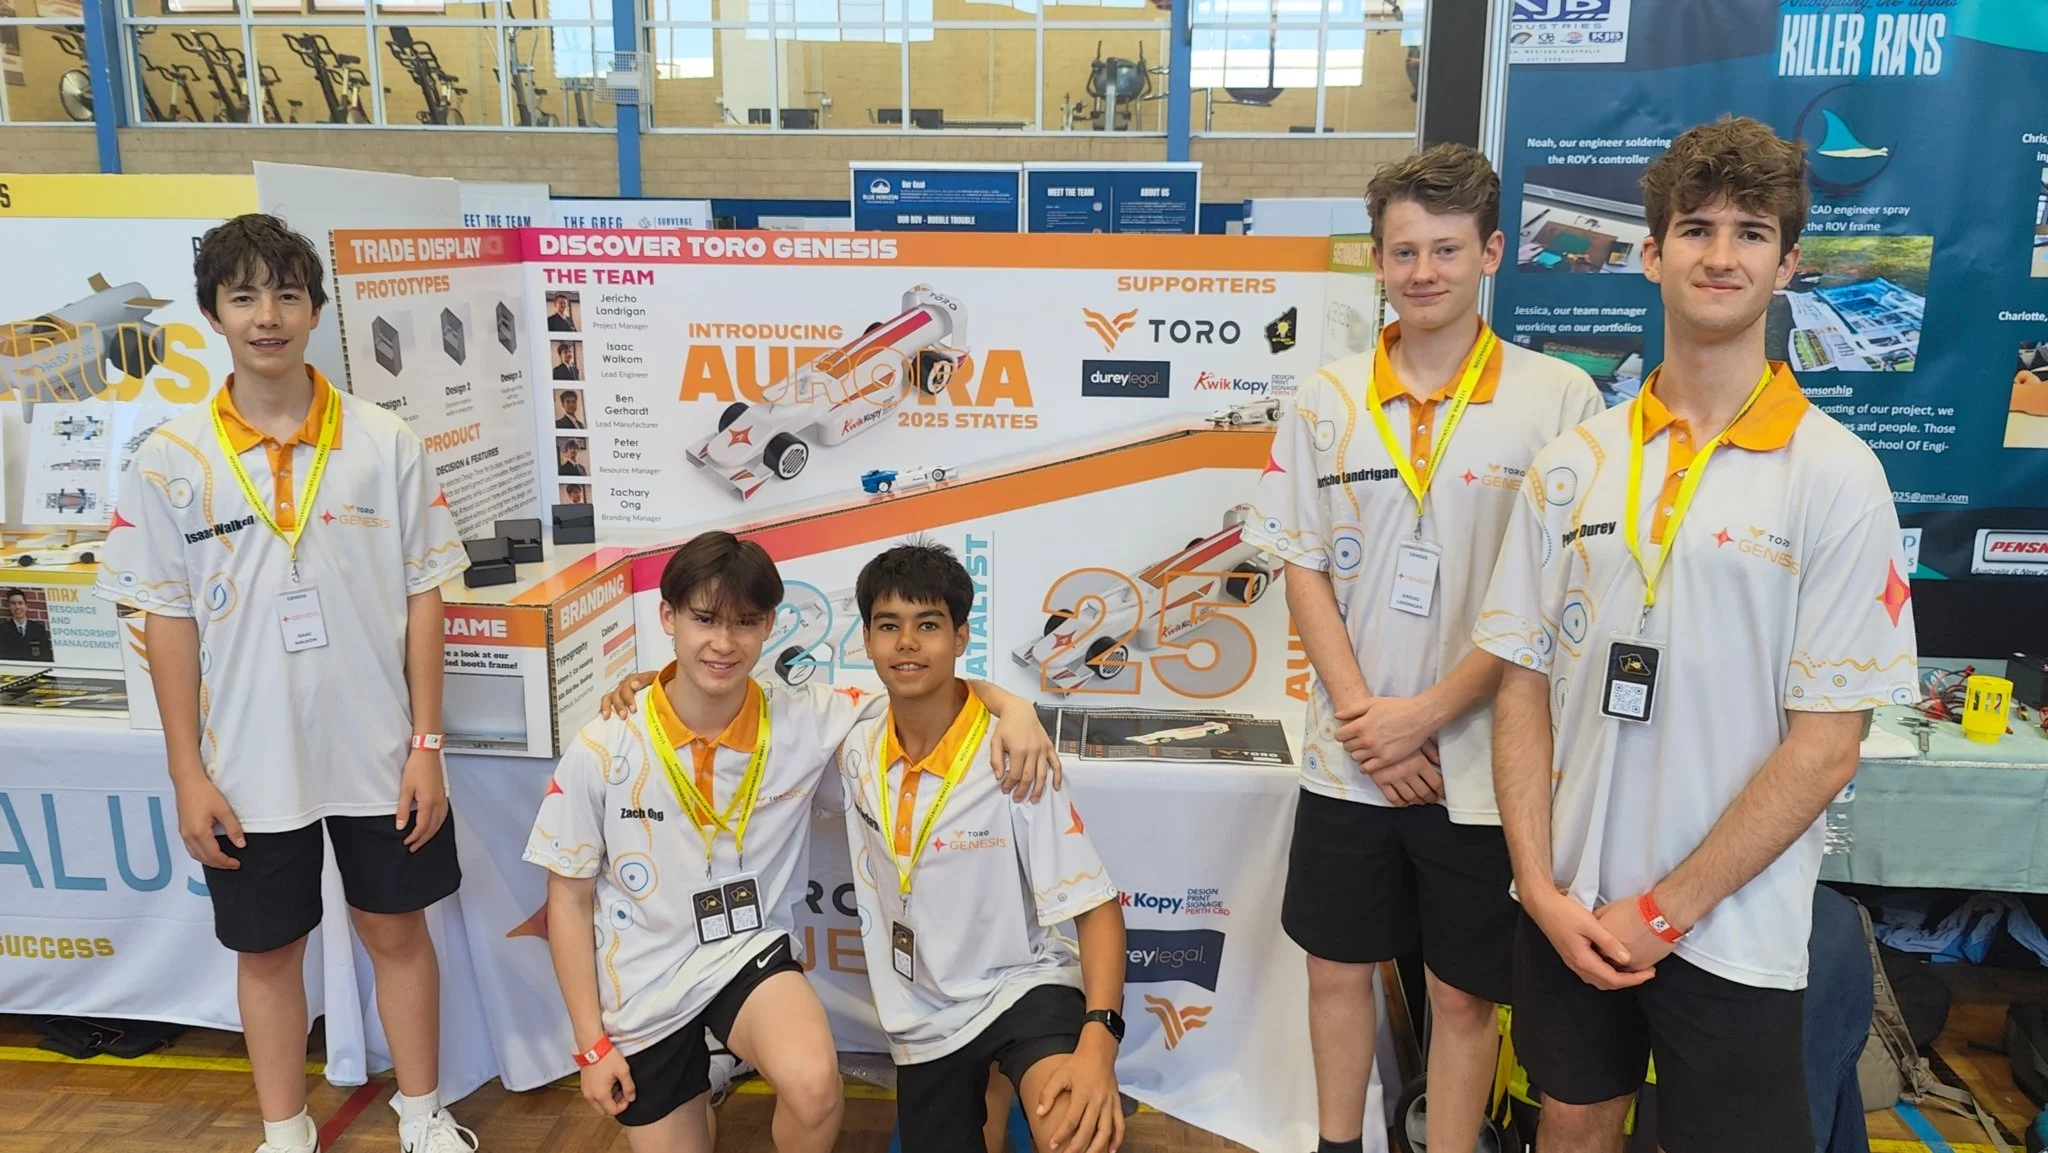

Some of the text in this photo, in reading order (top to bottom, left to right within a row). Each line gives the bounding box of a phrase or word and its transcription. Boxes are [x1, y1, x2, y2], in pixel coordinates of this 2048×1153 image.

[1778, 13, 1946, 77] KILLER RAYS
[1527, 137, 1672, 149] Noah, our engineer soldering
[1548, 155, 1650, 164] the ROV's controller
[1047, 188, 1094, 197] MEET THE TEAM
[1811, 205, 1910, 216] CAD engineer spray
[464, 214, 531, 228] EET THE TEAM
[563, 216, 587, 228] THE
[591, 217, 623, 229] GREG
[1807, 222, 1881, 231] the ROV frame
[351, 236, 482, 264] TRADE DISPLAY
[539, 235, 898, 260] DISCOVER TORO GENESIS
[543, 268, 655, 285] THE TEAM
[355, 274, 450, 300] PROTOTYPES
[1117, 276, 1276, 294] SUPPORTERS
[600, 293, 637, 304] Jericho
[596, 306, 646, 318] Landrigan
[1514, 306, 1551, 316] Jessica,
[1601, 308, 1647, 317] manager
[1999, 311, 2048, 321] Charlotte,
[592, 322, 649, 331] Project Manager
[688, 322, 844, 340] INTRODUCING
[1149, 319, 1241, 344] TORO
[1515, 323, 1556, 333] working
[1558, 324, 1572, 332] on
[1593, 323, 1643, 333] portfolios
[606, 342, 634, 353] Isaac
[602, 354, 643, 364] Walkom
[501, 373, 518, 383] Design
[601, 370, 649, 381] Lead Engineer
[679, 345, 1035, 408] AURORA
[1194, 371, 1231, 391] Kwik
[445, 382, 471, 396] Design 2
[1800, 385, 1853, 396] ponsorship
[615, 394, 634, 403] Ben
[604, 406, 649, 416] Gerhardt
[1821, 403, 1954, 416] costing of our project, we
[614, 421, 659, 429] Manufacturer
[898, 411, 1038, 430] 2025 STATES
[1857, 423, 1877, 431] and
[1879, 424, 1920, 434] people.
[1924, 423, 1956, 433] Those
[424, 423, 481, 455] PRODUCT
[613, 438, 639, 447] Peter
[1869, 440, 1949, 453] School Of Engi-
[436, 447, 500, 476] DECISION & FEATURES
[613, 451, 641, 461] Durey
[632, 467, 661, 475] Manager
[1342, 468, 1398, 485] Landrigan
[1503, 466, 1526, 477] TORO
[1481, 476, 1522, 491] GENE
[610, 488, 650, 499] Zachary
[1892, 491, 1968, 503] 025@gmail.com
[620, 500, 641, 510] Ong
[338, 514, 391, 529] GENESIS
[601, 514, 662, 523] Branding Manager
[1580, 521, 1616, 538] Durey
[48, 588, 79, 602] MAX
[560, 574, 625, 631] BRANDING
[966, 533, 988, 678] ATALYST
[49, 605, 97, 614] RESOURCE
[51, 616, 71, 625] AND
[52, 628, 117, 638] SPONSORSHIP
[601, 621, 618, 637] Colours
[1041, 567, 1258, 698] 25
[54, 640, 120, 650] MANAGEMENT
[461, 650, 480, 658] look
[556, 641, 588, 667] Typography
[461, 660, 518, 669] booth frame!
[620, 808, 645, 819] Zach
[968, 830, 989, 838] TORO
[0, 792, 211, 897] ALU
[950, 837, 1007, 851] GENESIS
[1185, 907, 1230, 916] PERTH CBD
